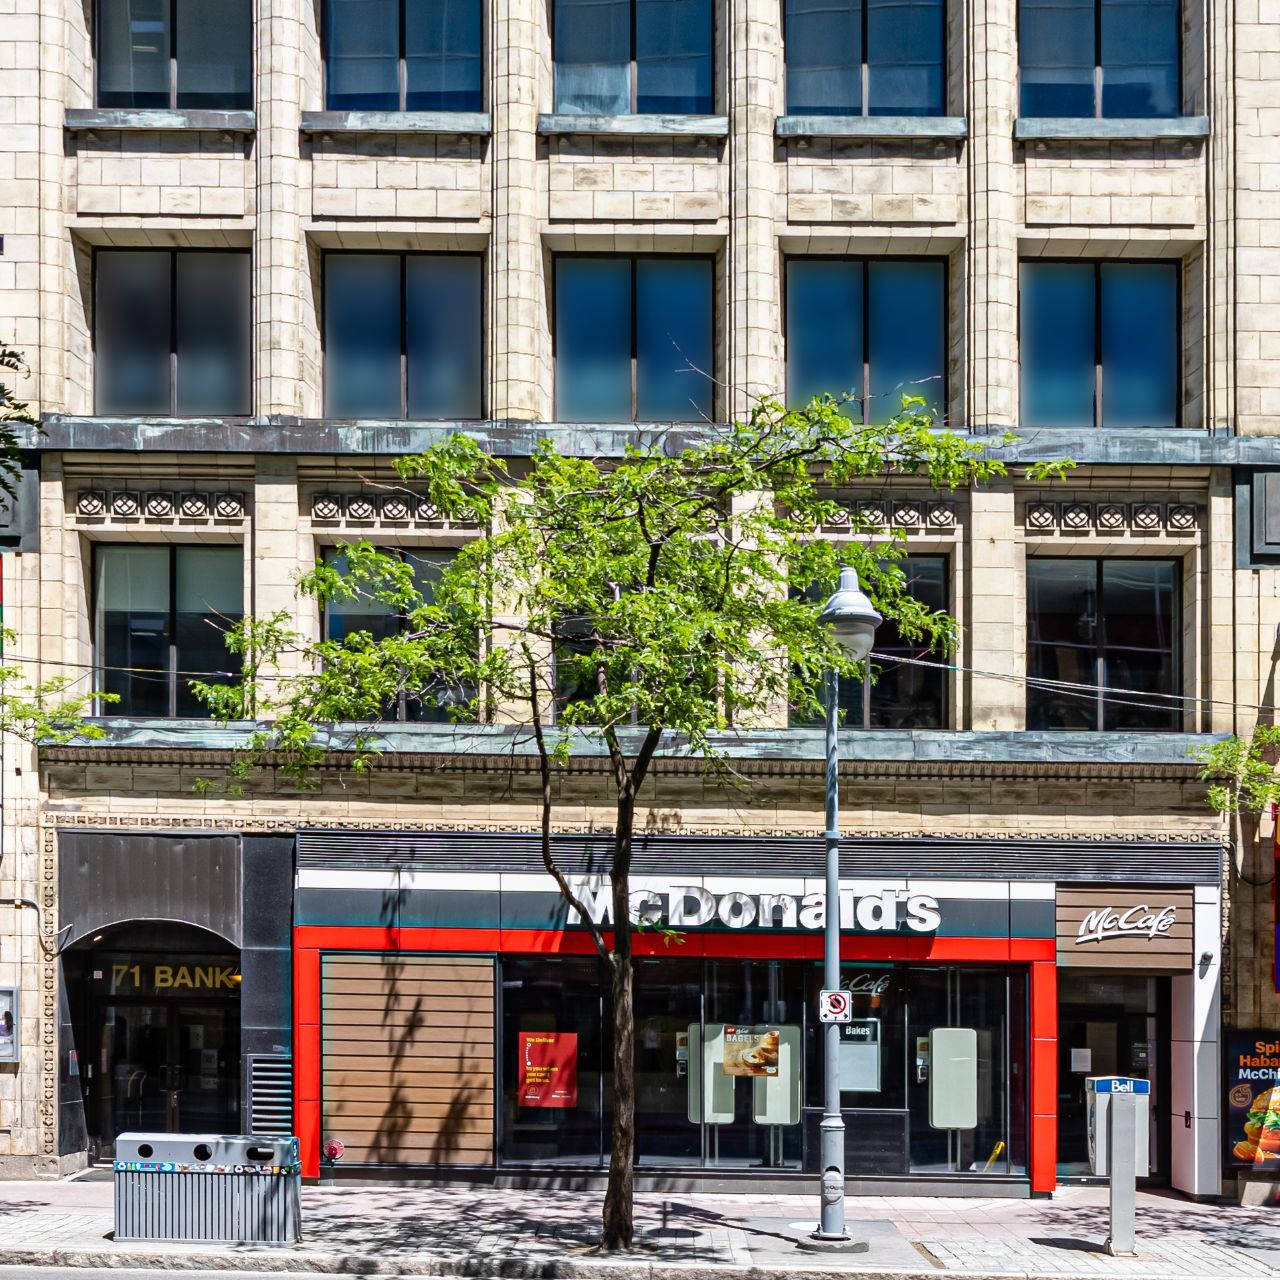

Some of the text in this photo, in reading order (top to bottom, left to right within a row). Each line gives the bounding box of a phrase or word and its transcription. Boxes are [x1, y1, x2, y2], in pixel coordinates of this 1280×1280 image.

[566, 883, 942, 933] McDonald's
[1077, 904, 1177, 942] McCafé
[112, 965, 236, 988] 71 BANK
[726, 1034, 760, 1043] BAGELS
[845, 1025, 871, 1036] Bakes
[1111, 1080, 1134, 1093] Bell
